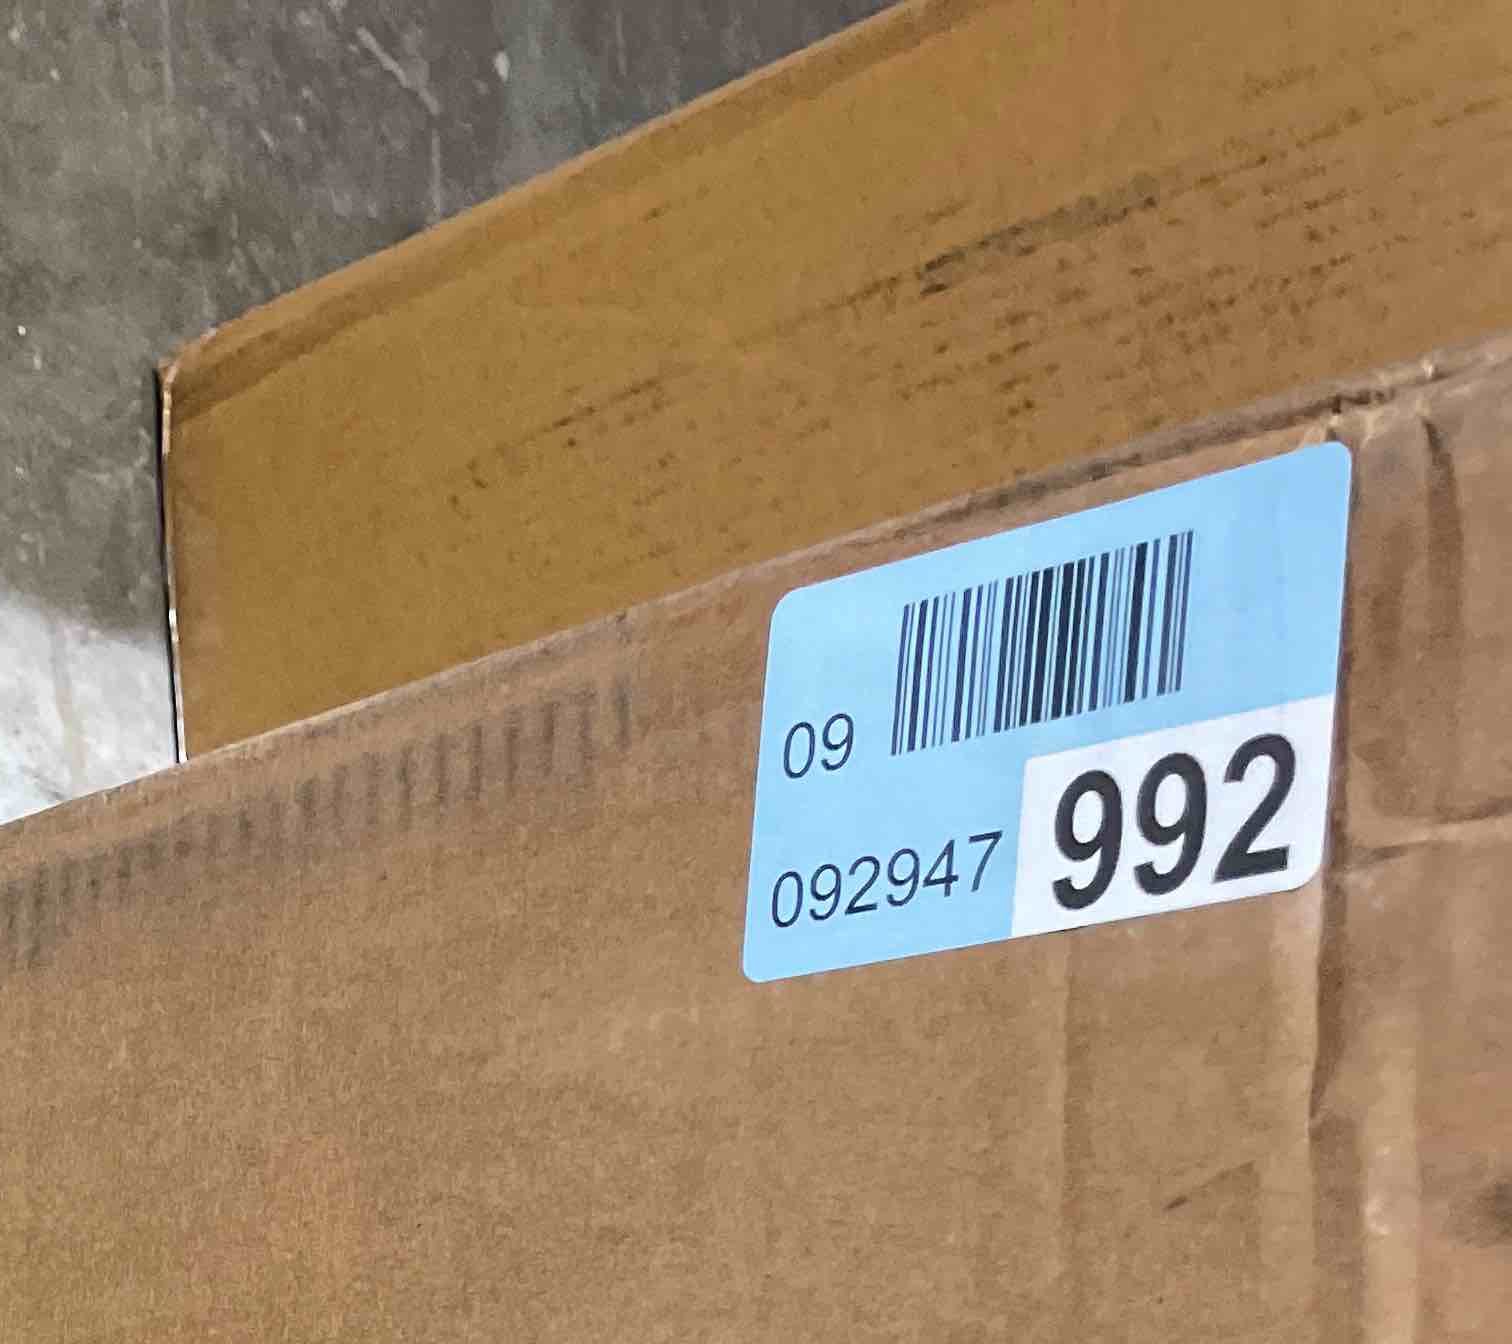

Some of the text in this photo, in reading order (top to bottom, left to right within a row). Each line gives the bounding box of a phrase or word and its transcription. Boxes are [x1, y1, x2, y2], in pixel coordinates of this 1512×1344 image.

[782, 712, 855, 780] 09
[1051, 732, 1297, 911] 992
[770, 830, 1004, 929] 092947
